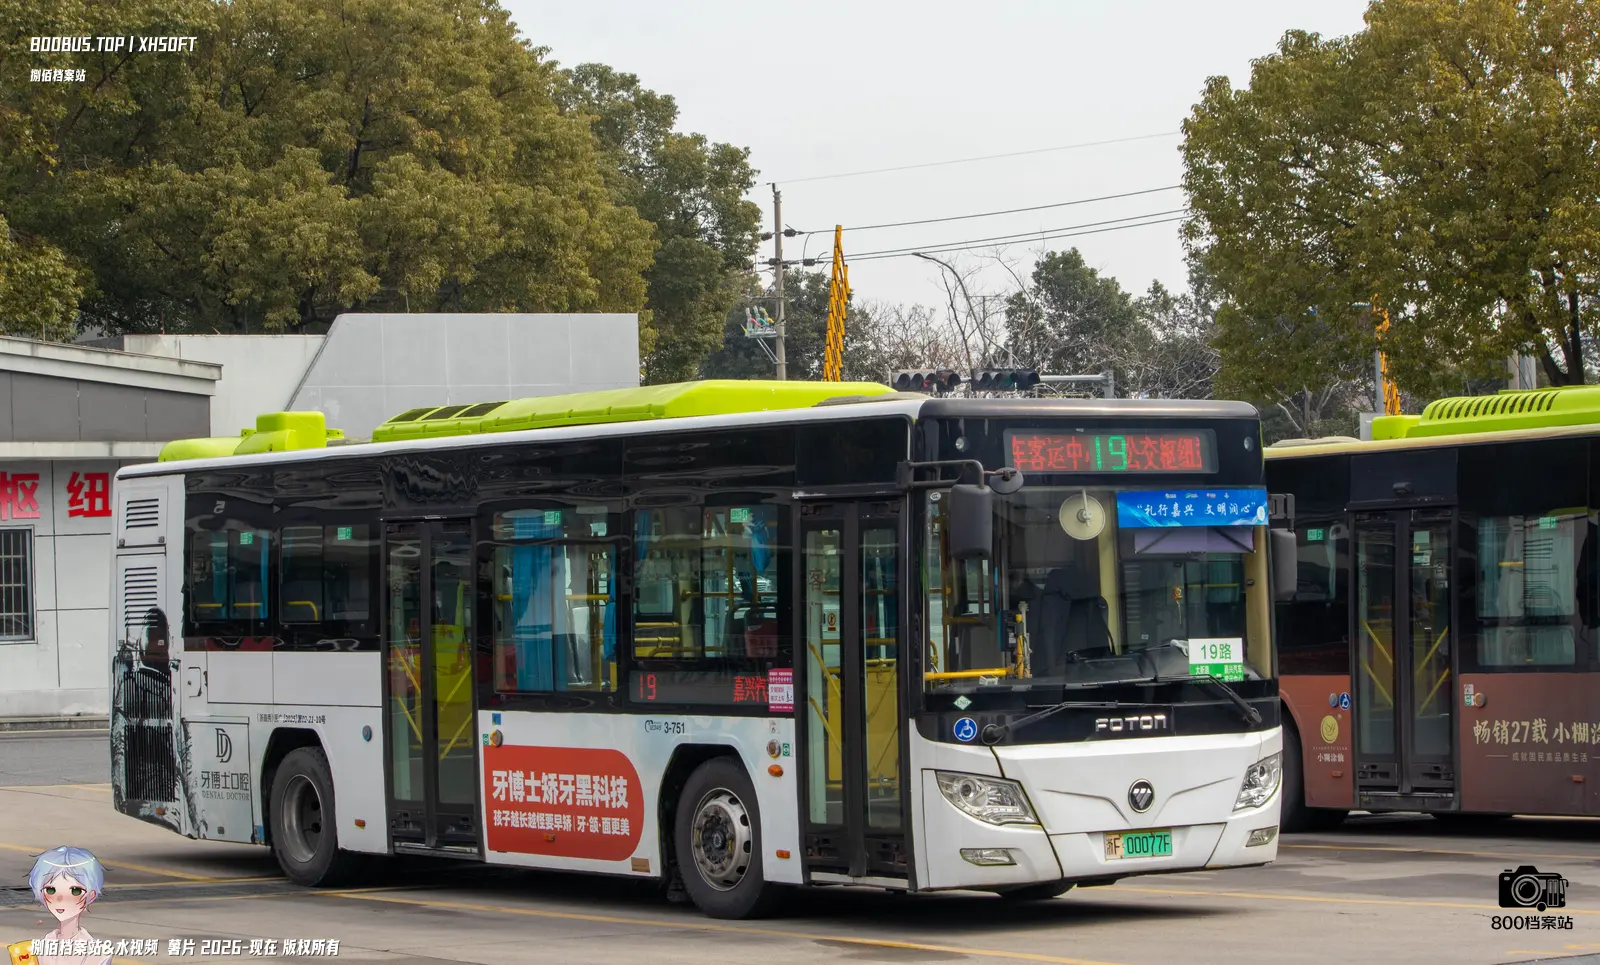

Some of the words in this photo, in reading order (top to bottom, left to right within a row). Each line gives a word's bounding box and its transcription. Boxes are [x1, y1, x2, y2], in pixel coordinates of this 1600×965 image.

[1011, 435, 1090, 470] 车客运中
[1094, 435, 1127, 471] 19
[0, 471, 112, 521] 枢纽
[1200, 643, 1232, 660] 19路
[639, 673, 657, 700] 19
[664, 721, 685, 734] 3-751
[1095, 714, 1167, 732] FOTON
[1472, 717, 1549, 745] 畅销27载
[1512, 751, 1588, 763] 成就国民高品质生活
[201, 770, 250, 791] 牙博士口腔
[491, 769, 629, 809] 牙博士矫牙黑科技
[202, 790, 225, 799] DENTAL
[226, 791, 250, 801] DOCTOR
[1126, 834, 1170, 855] 00077F
